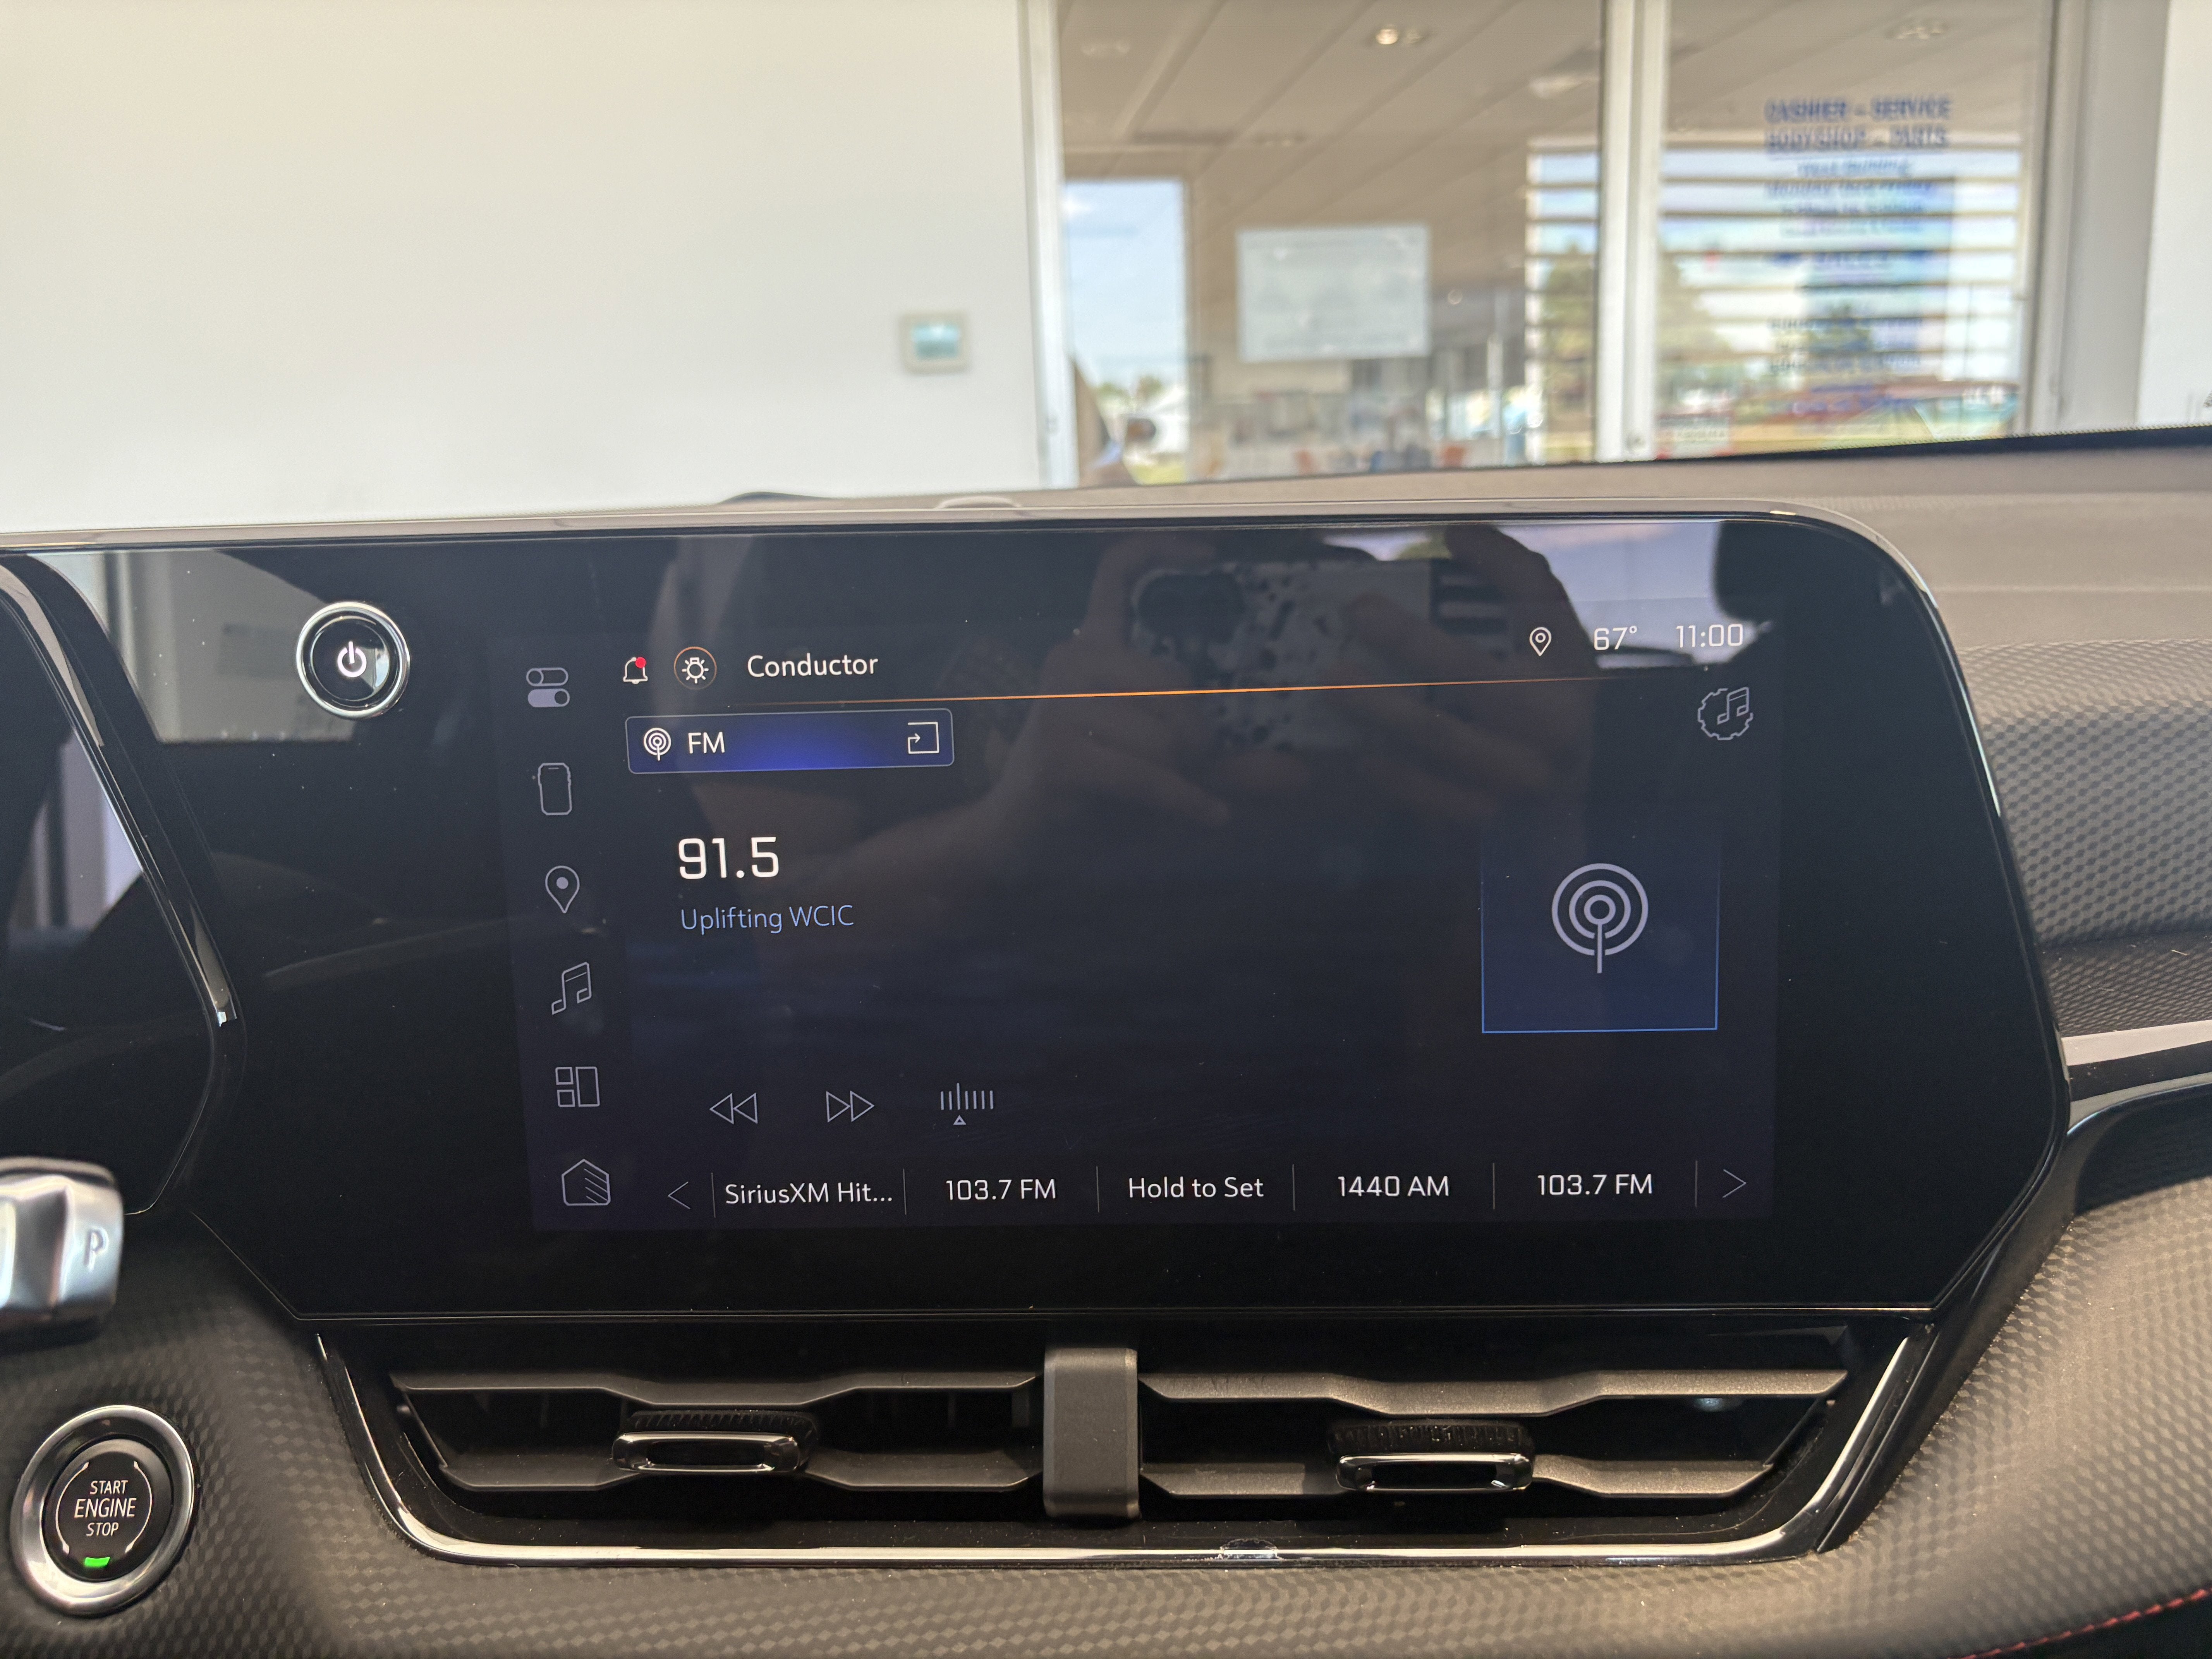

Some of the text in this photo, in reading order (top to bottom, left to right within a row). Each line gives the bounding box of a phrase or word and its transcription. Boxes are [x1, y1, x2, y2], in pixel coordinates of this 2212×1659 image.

[1594, 625, 1637, 651] 67°
[1676, 623, 1744, 648] 11:00
[747, 652, 879, 678] Conductor
[687, 731, 725, 754] FM
[678, 836, 780, 880] 91.5
[681, 904, 854, 935] Uplifting WCIC
[725, 1182, 893, 1204] SiriusXM Hit...
[946, 1178, 1056, 1200] 103.7 FM
[1128, 1176, 1264, 1198] Hold to Set
[1338, 1175, 1449, 1197] 1440 AM
[1537, 1173, 1653, 1196] 103.7 FM
[84, 1226, 109, 1270] P
[89, 1479, 129, 1495] START
[74, 1497, 137, 1518] ENGINE
[86, 1522, 119, 1537] STOP
